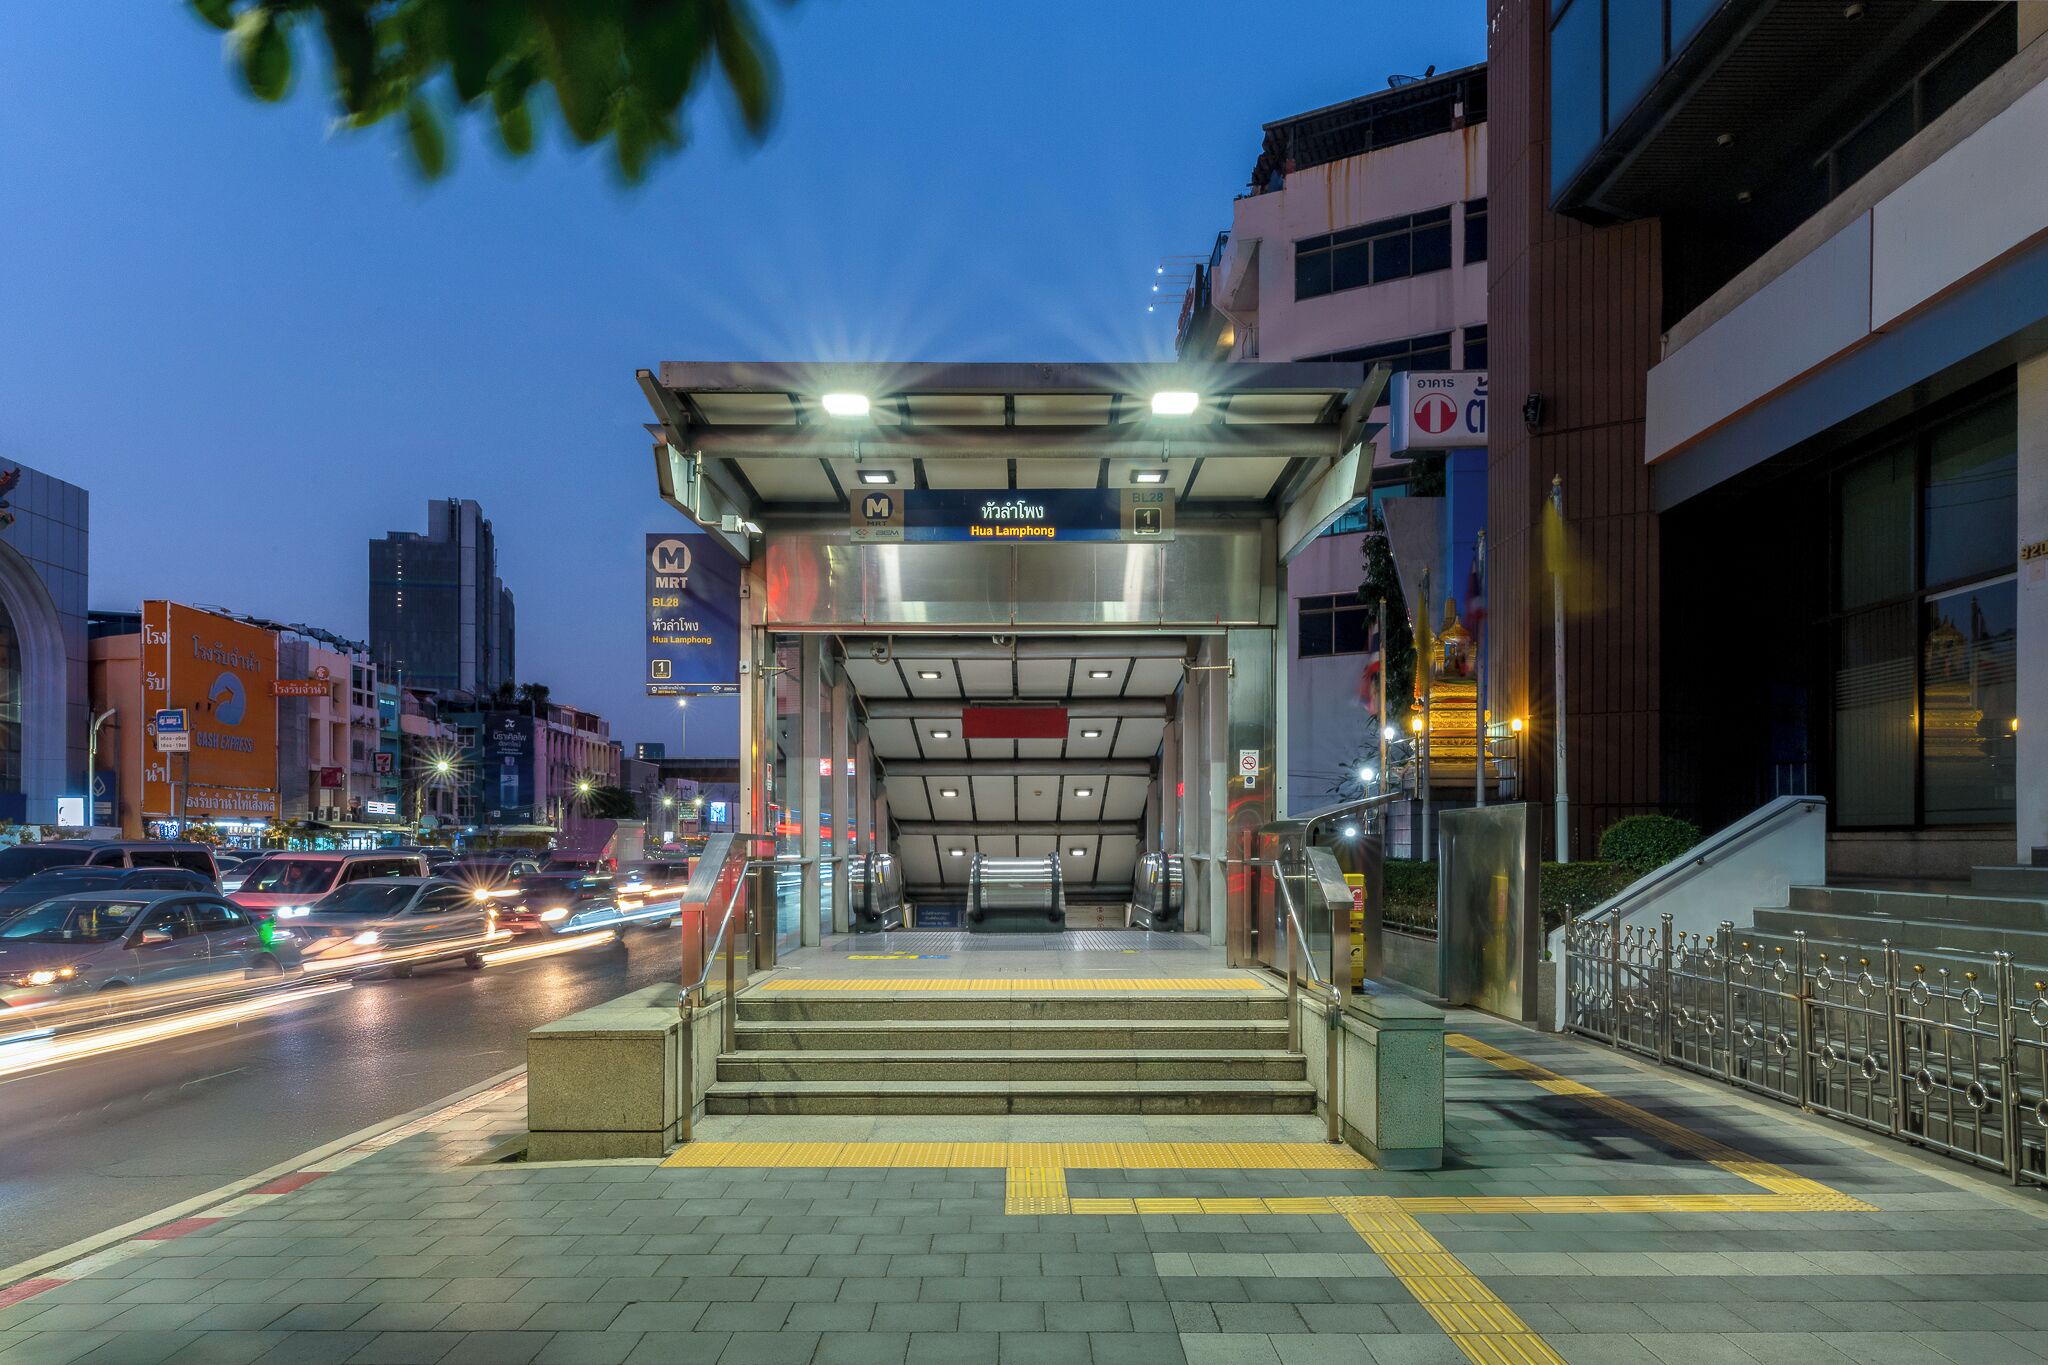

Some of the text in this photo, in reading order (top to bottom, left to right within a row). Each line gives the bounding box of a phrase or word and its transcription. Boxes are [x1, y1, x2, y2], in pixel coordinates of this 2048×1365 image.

[1417, 378, 1455, 389] อาคาร
[1132, 492, 1164, 503] BL28
[981, 500, 1044, 519] หัวลำโพง
[1143, 510, 1151, 525] 1
[971, 525, 1055, 538] Hua Lamphong
[655, 576, 688, 589] MRT
[652, 597, 679, 607] BL28
[652, 617, 699, 631] หัวลำโพง
[144, 624, 167, 645] โรง
[652, 635, 712, 645] Hua Lamphong
[192, 634, 261, 673] โรงรับจำนำ
[658, 661, 664, 672] 1
[146, 671, 165, 691] รับ
[273, 681, 327, 695] โรงรับจำนำ
[196, 732, 255, 753] CASH EXPRESS
[145, 762, 166, 782] นำ
